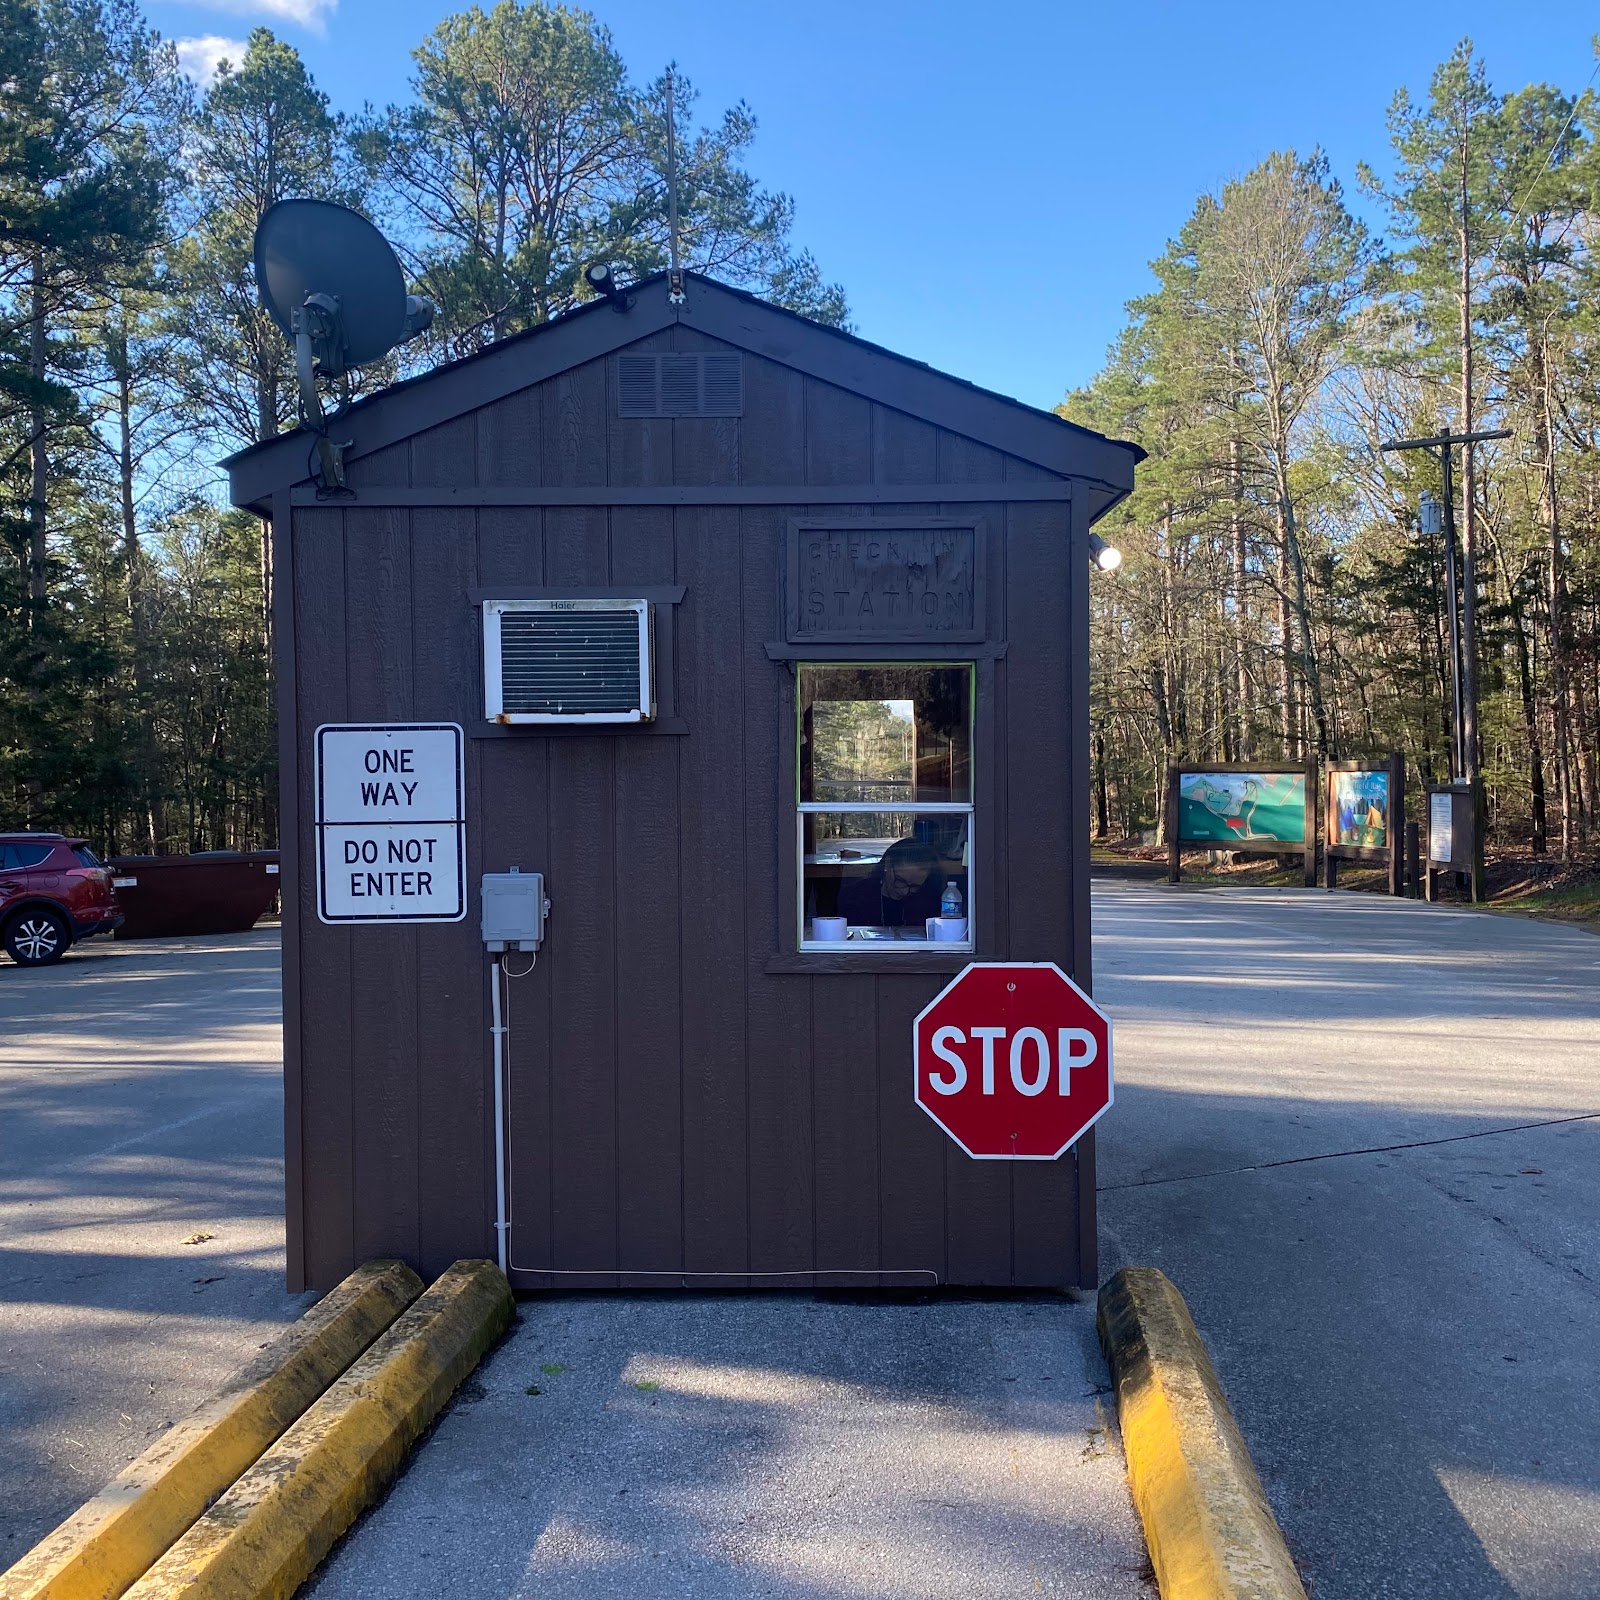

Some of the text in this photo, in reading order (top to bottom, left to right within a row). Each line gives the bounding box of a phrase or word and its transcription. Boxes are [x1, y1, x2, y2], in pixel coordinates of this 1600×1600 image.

[808, 542, 901, 560] CHECK
[551, 600, 576, 609] Haier
[808, 591, 964, 617] STATION
[364, 749, 414, 773] ONE
[361, 782, 418, 806] WAY
[344, 839, 437, 864] DO NOT
[351, 872, 432, 896] ENTER
[929, 1025, 1098, 1096] STOP
